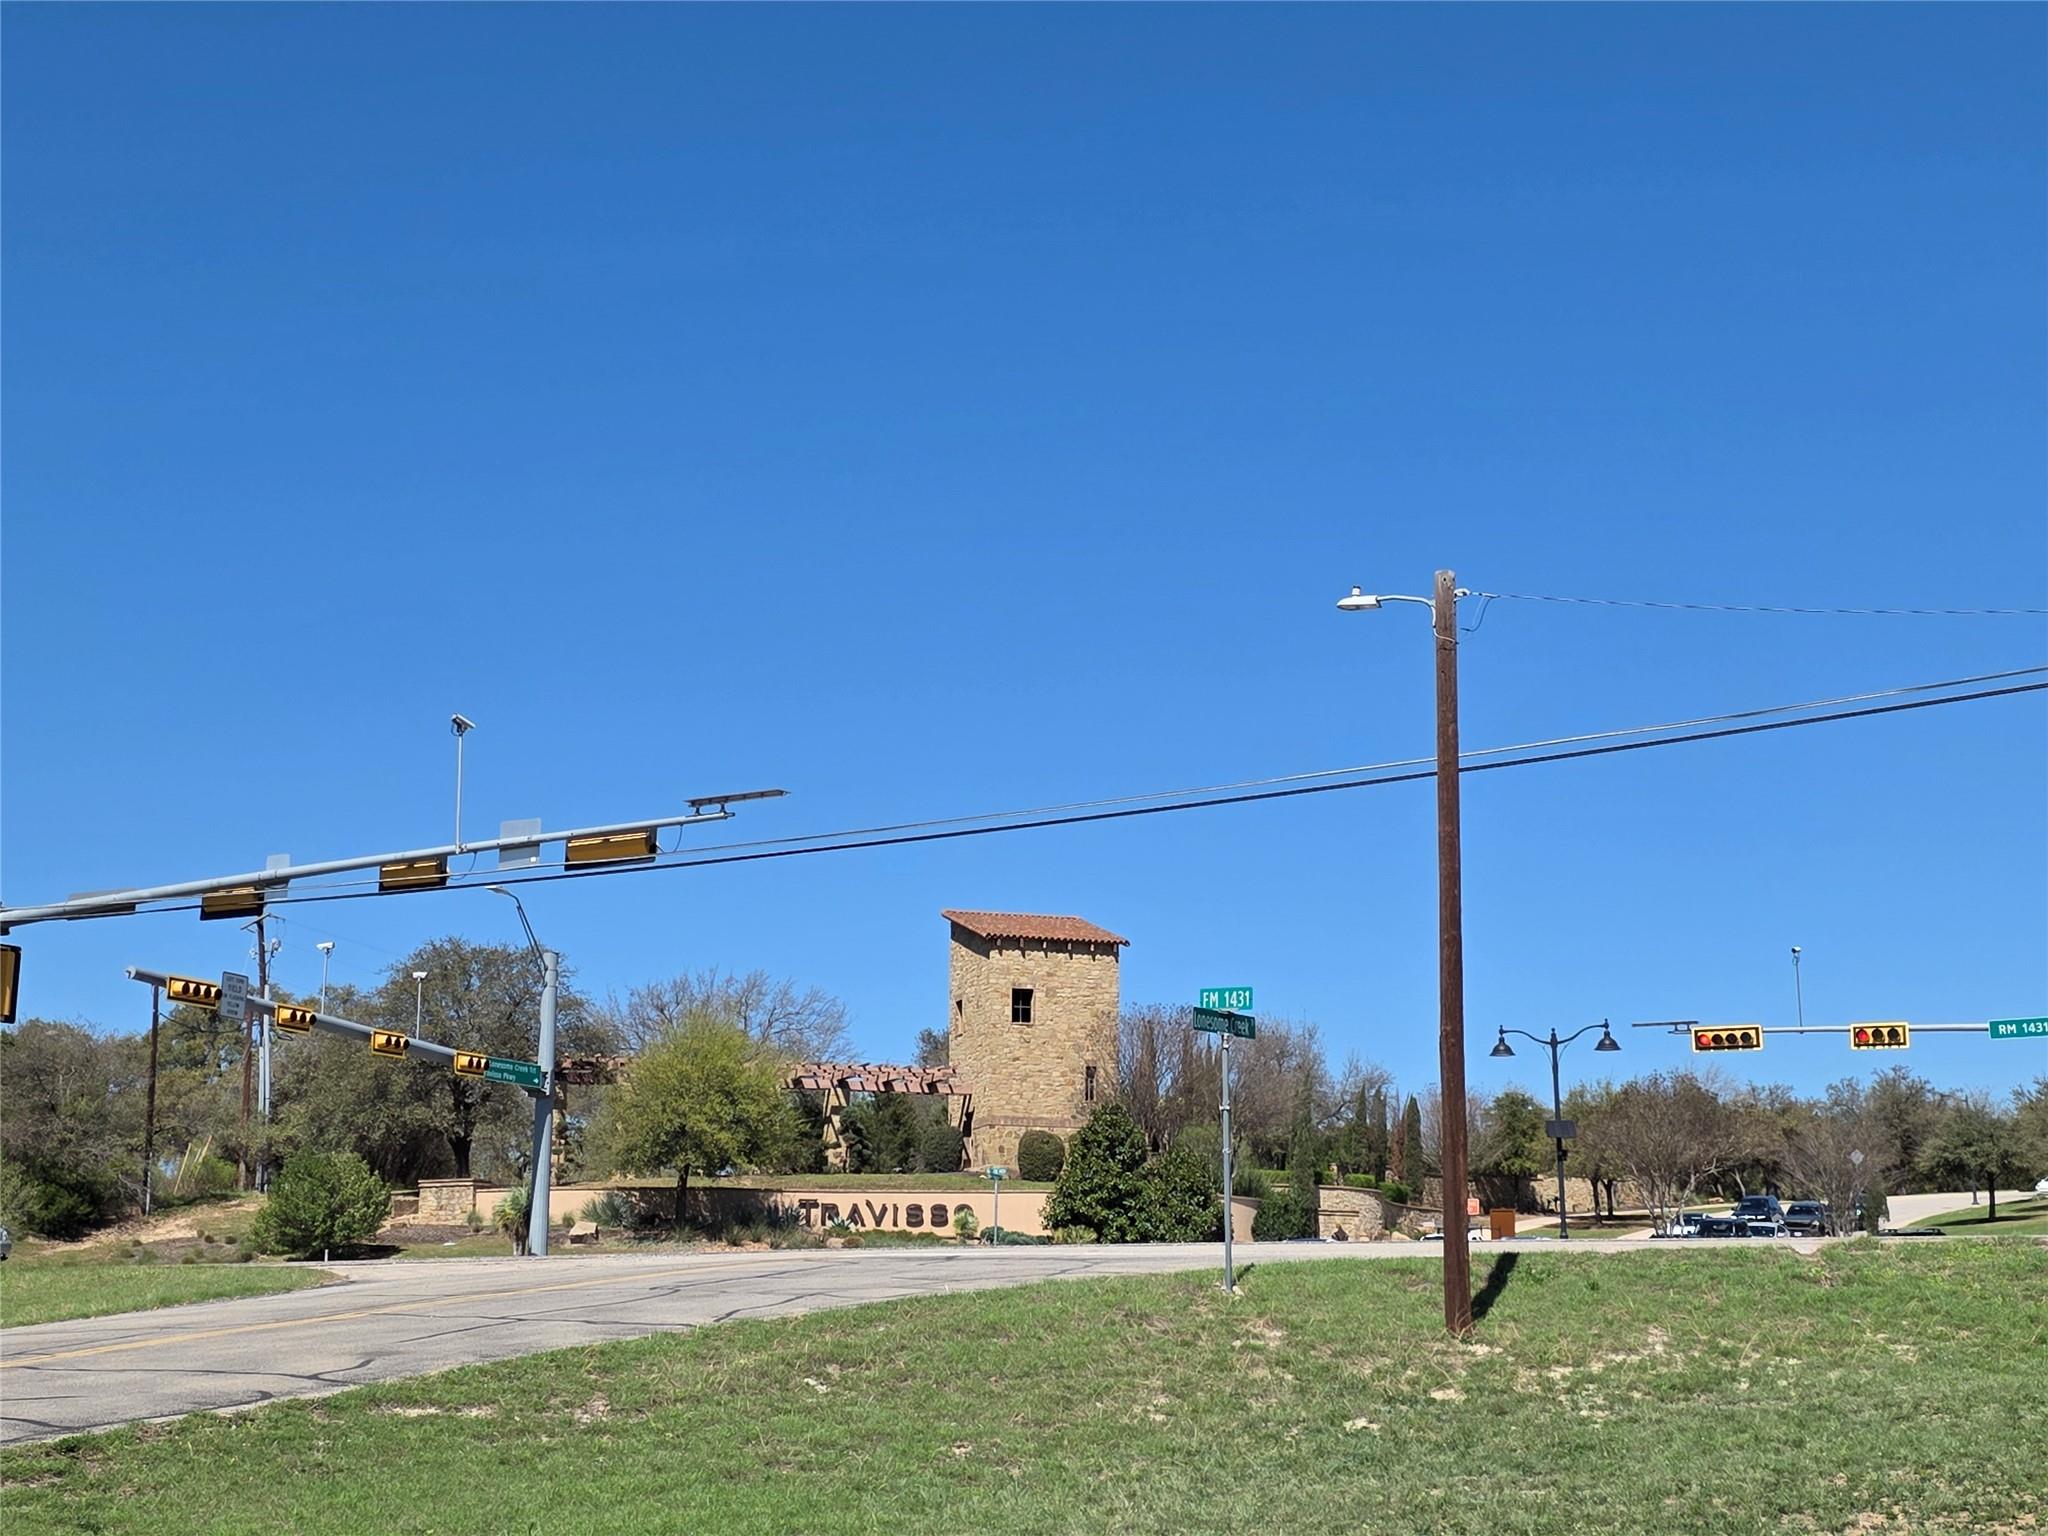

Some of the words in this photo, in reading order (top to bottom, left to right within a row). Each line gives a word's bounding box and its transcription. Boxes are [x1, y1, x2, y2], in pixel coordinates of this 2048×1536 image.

[1203, 992, 1219, 1008] FM
[1224, 990, 1250, 1008] 1431
[1194, 1011, 1229, 1032] Lonesome
[1231, 1017, 1249, 1035] Creek
[1998, 1023, 2017, 1035] RM
[2022, 1022, 2048, 1034] 1431
